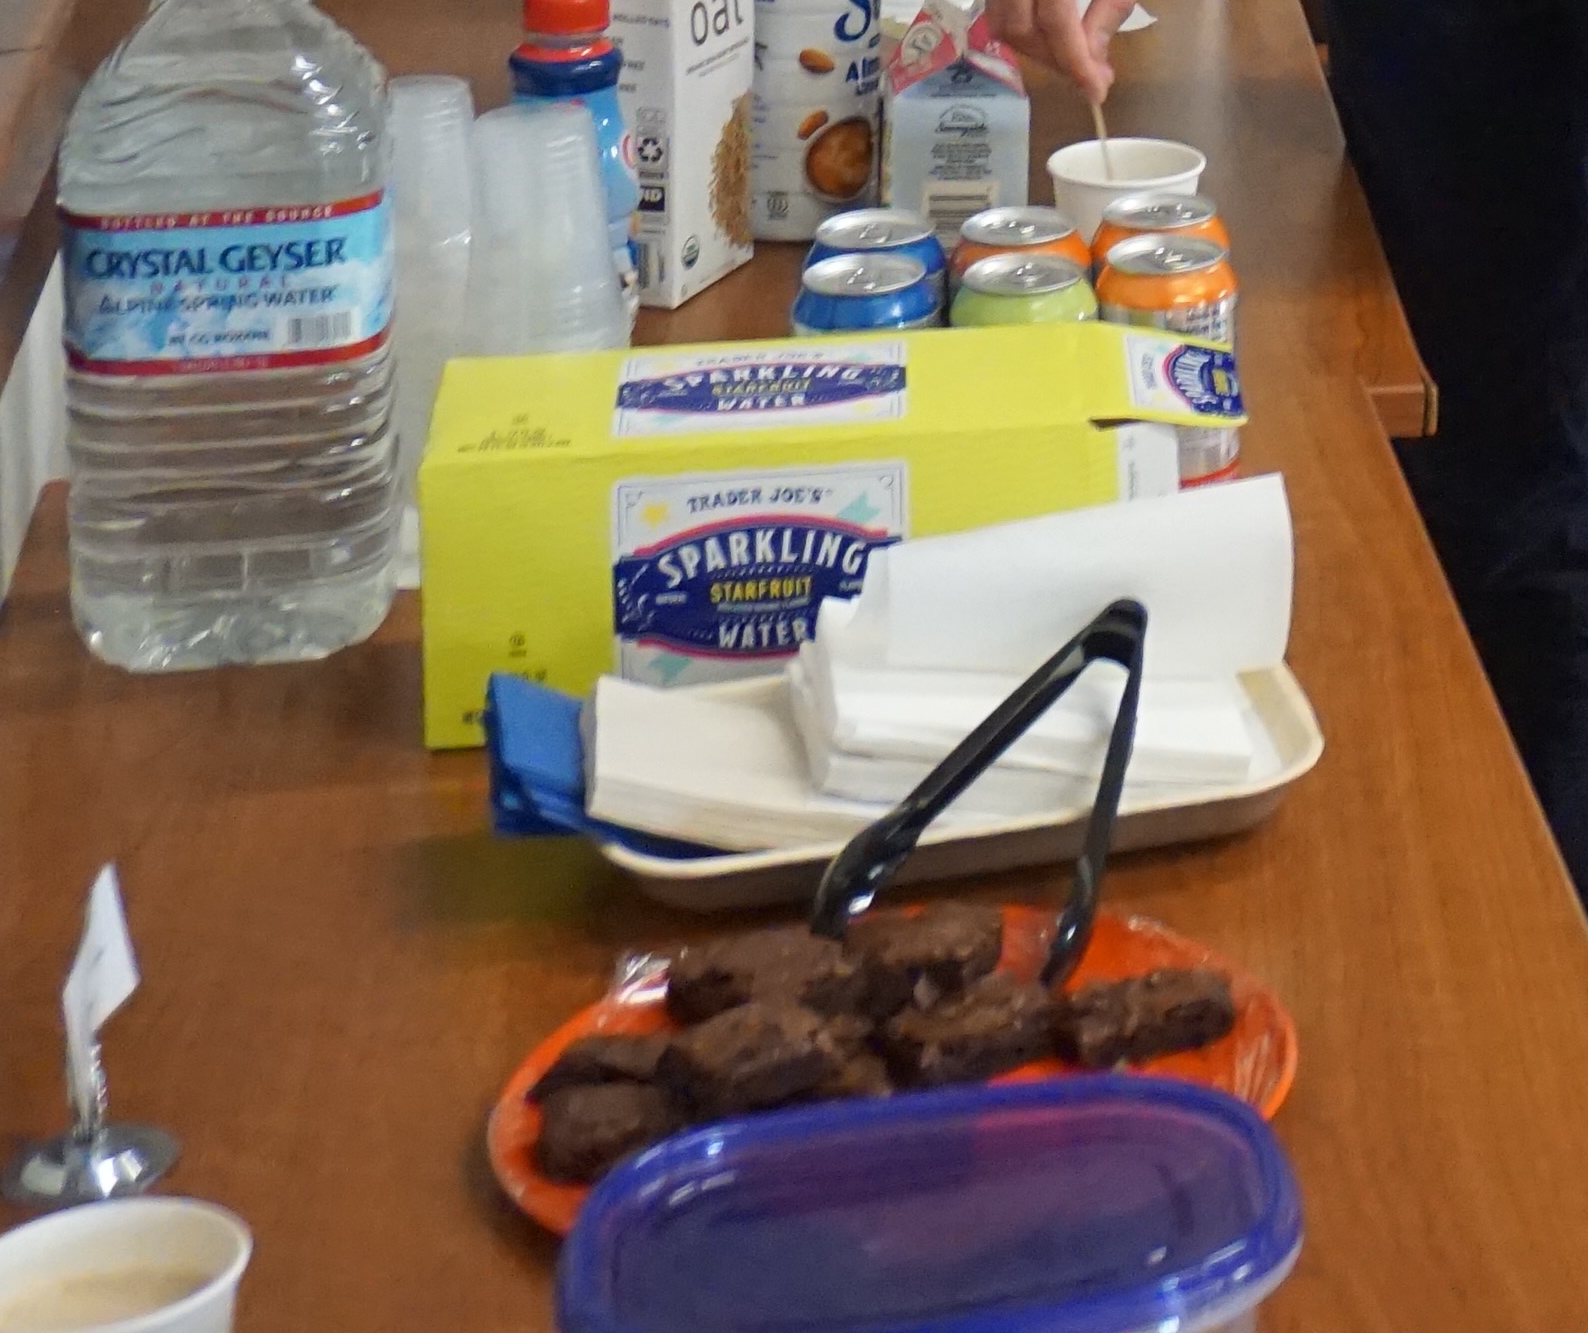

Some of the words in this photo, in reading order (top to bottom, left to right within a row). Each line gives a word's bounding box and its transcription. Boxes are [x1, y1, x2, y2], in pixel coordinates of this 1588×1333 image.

[189, 213, 209, 227] AT
[222, 210, 254, 225] THE
[265, 205, 334, 224] SOURCE
[85, 246, 214, 280] CRYSTAL
[218, 236, 348, 274] GEYSER
[263, 285, 337, 306] WATER
[663, 363, 864, 392] SPARKLING
[717, 394, 807, 412] WATER
[686, 487, 763, 513] TRADER
[768, 485, 825, 505] JOE'S
[656, 526, 868, 589] SPARKLING
[710, 576, 814, 604] STARFRUIT
[717, 617, 809, 650] WATER
